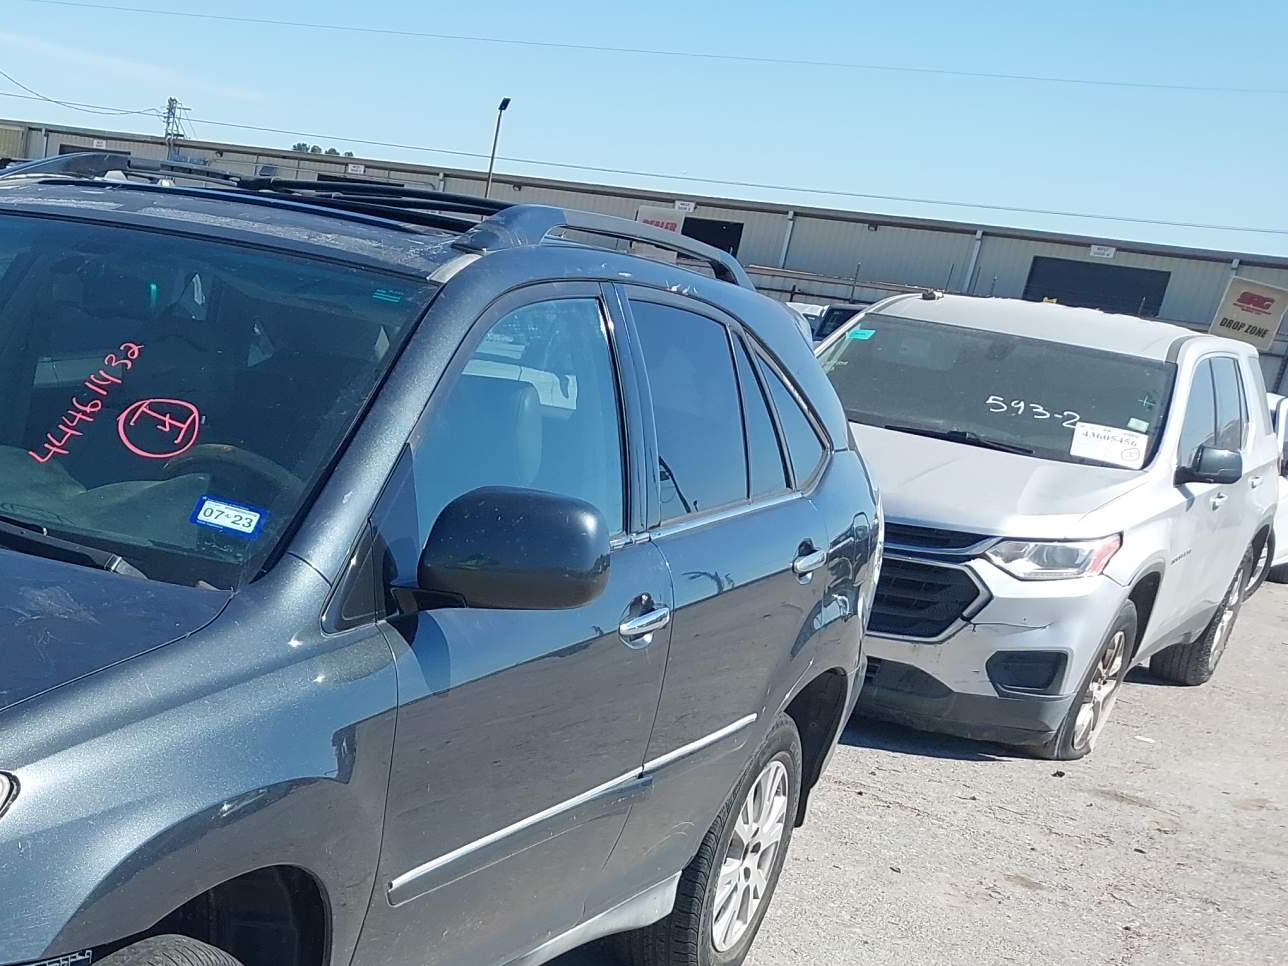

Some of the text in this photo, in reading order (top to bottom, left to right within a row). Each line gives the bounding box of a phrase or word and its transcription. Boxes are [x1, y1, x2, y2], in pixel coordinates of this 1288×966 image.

[1219, 317, 1269, 338] DROP ZONE
[28, 342, 144, 463] 44461432
[203, 507, 225, 519] 07
[231, 514, 253, 528] 23
